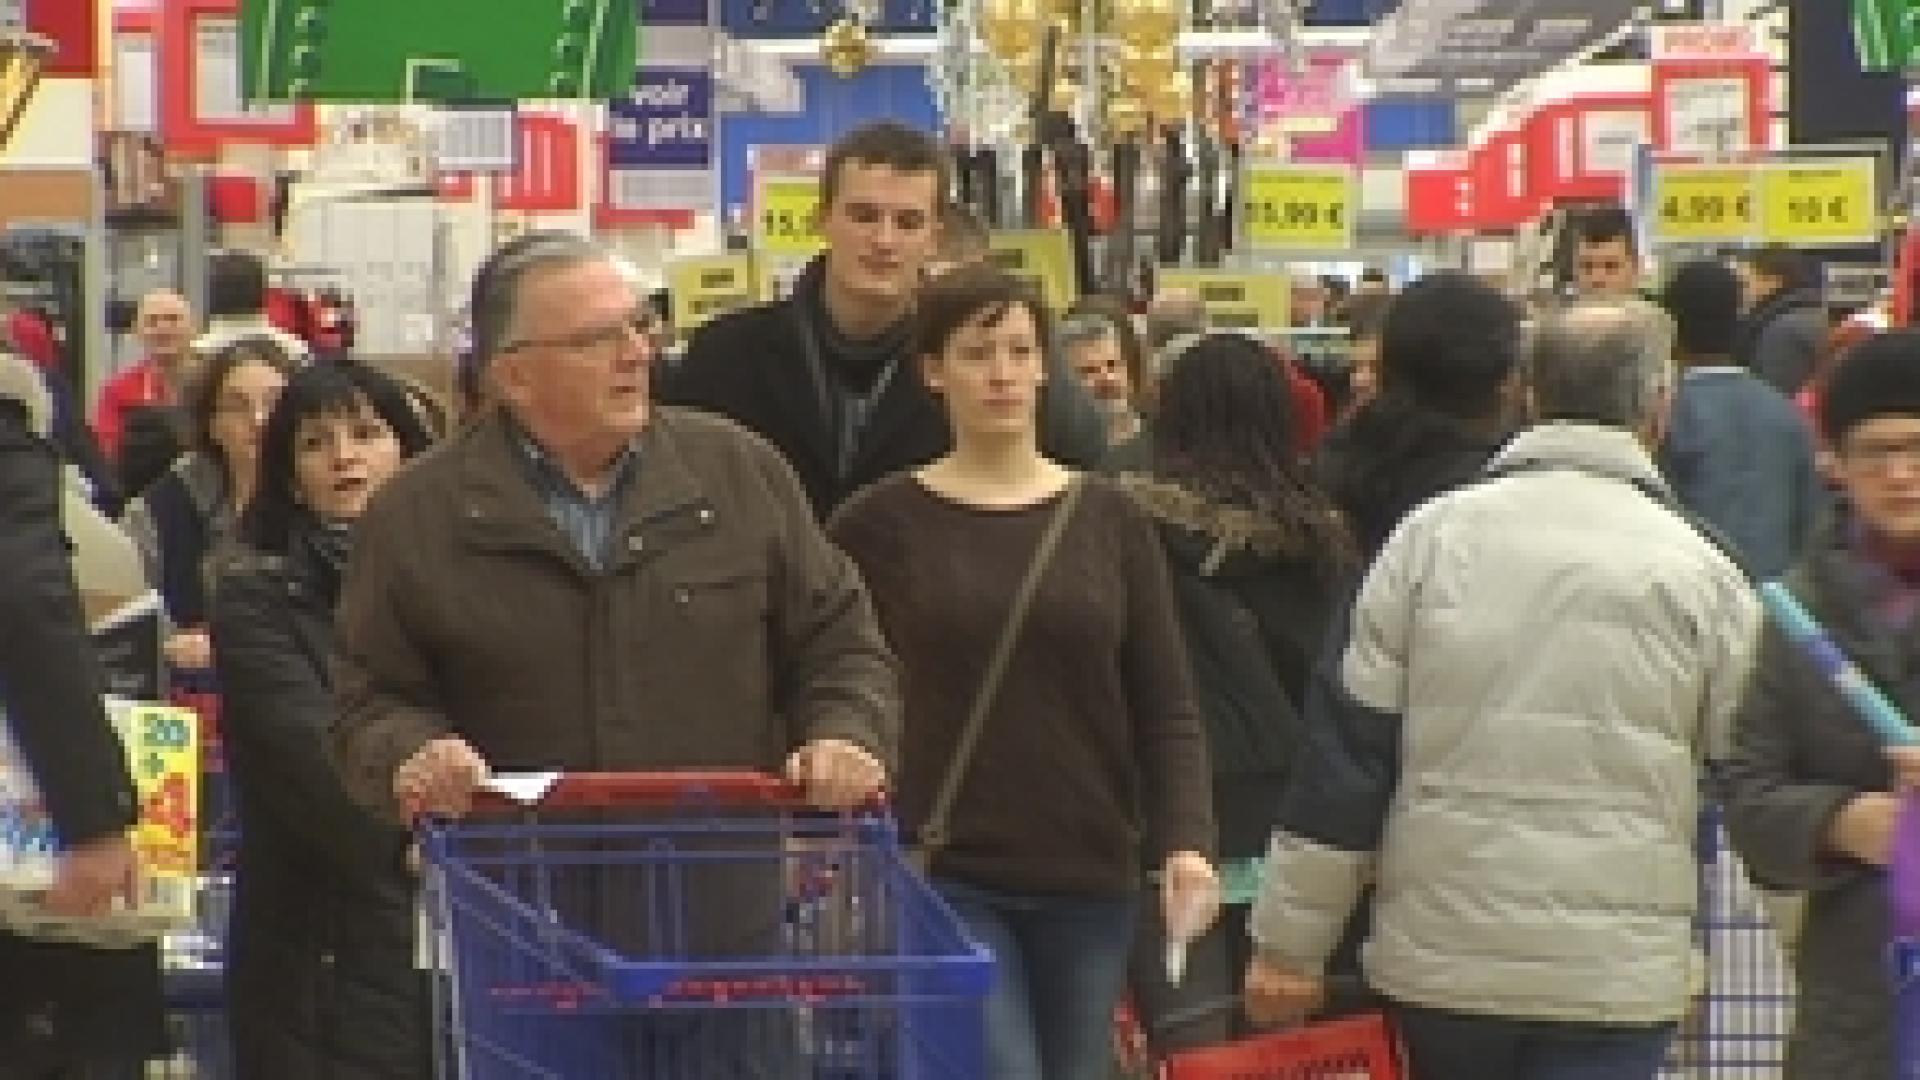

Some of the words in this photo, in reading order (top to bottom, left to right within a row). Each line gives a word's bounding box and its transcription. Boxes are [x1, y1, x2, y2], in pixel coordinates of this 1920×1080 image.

[632, 79, 690, 107] voir
[648, 113, 707, 147] prix
[1325, 202, 1345, 229] €
[1735, 193, 1753, 224] €
[1828, 197, 1848, 222] €
